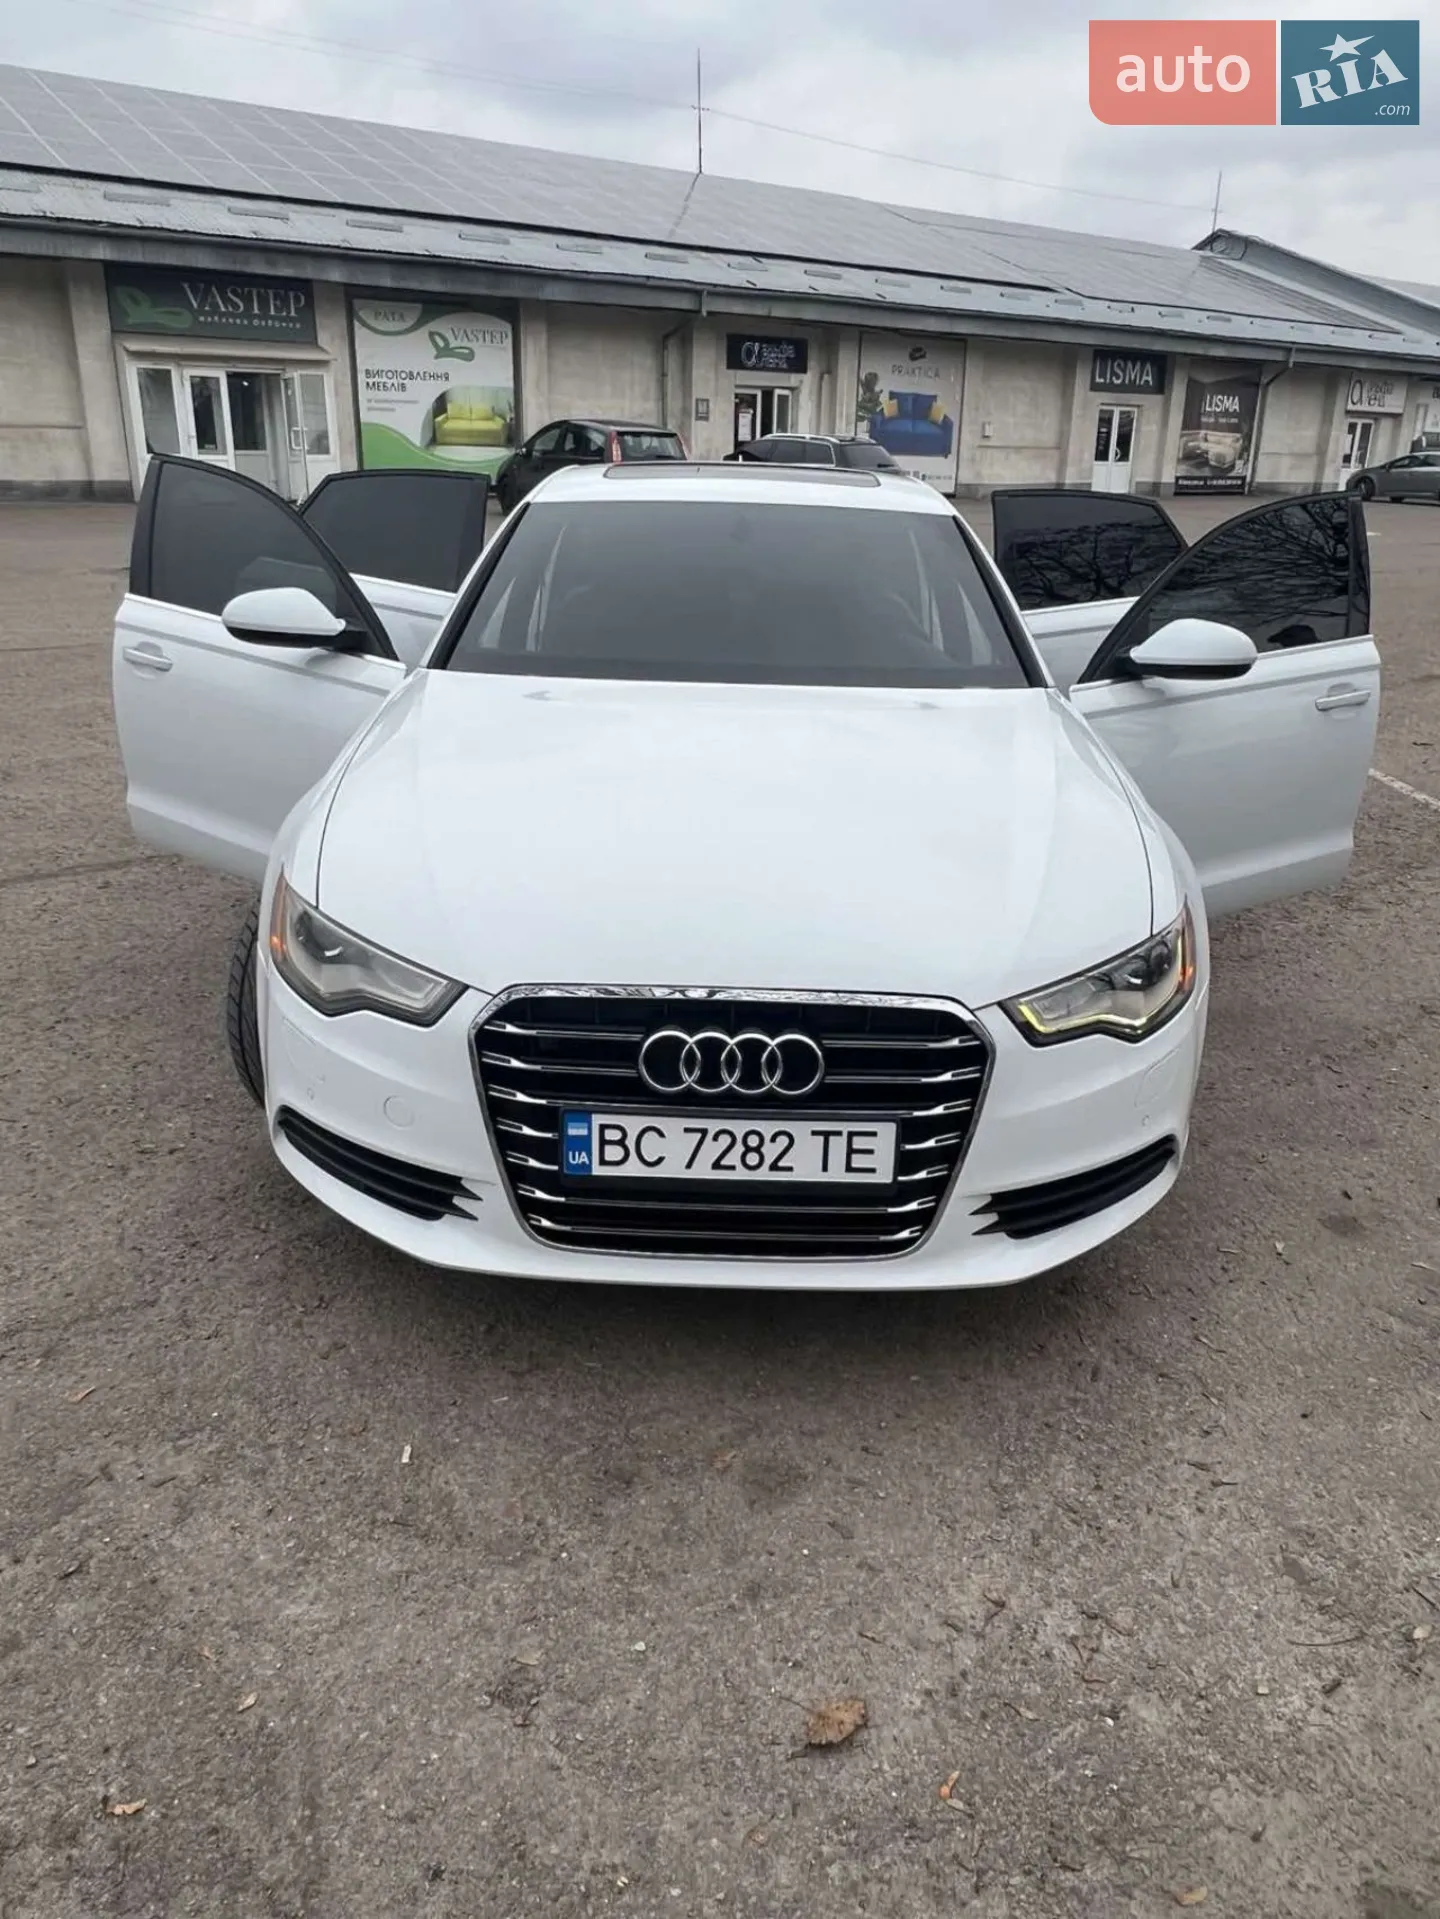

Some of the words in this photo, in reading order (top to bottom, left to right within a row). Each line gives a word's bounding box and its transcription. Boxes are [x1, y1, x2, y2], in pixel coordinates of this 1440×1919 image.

[365, 368, 450, 382] ВИГОТОВЛЕННЯ
[1095, 357, 1153, 387] LISMA
[365, 381, 408, 393] МЕБЛІВ
[1205, 394, 1240, 413] LISMA
[597, 1122, 667, 1168] BC
[682, 1126, 796, 1173] 7282
[810, 1129, 879, 1174] TE
[568, 1151, 590, 1166] UA
